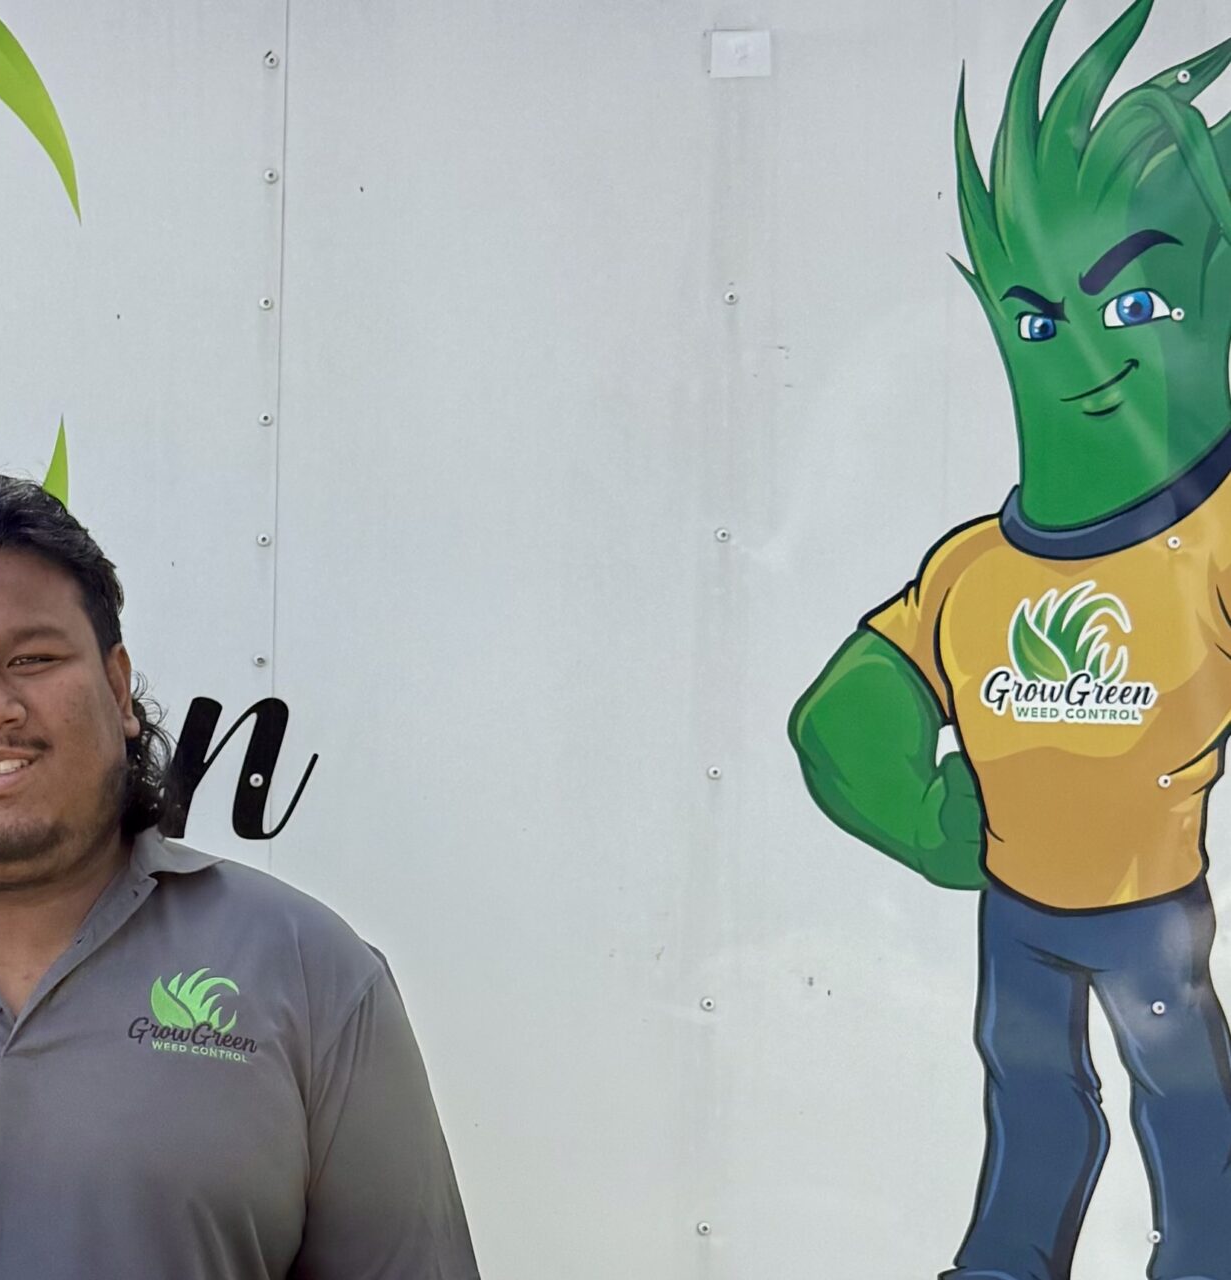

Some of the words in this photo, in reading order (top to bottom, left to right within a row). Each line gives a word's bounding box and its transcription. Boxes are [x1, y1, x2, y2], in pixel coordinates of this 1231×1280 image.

[983, 670, 1154, 711] GrowGreen
[1016, 706, 1059, 718] WEED
[1065, 708, 1139, 721] CONTROL
[128, 1017, 257, 1054] GrowGreen
[152, 1040, 187, 1053] WEED
[191, 1045, 248, 1063] CONTROL
